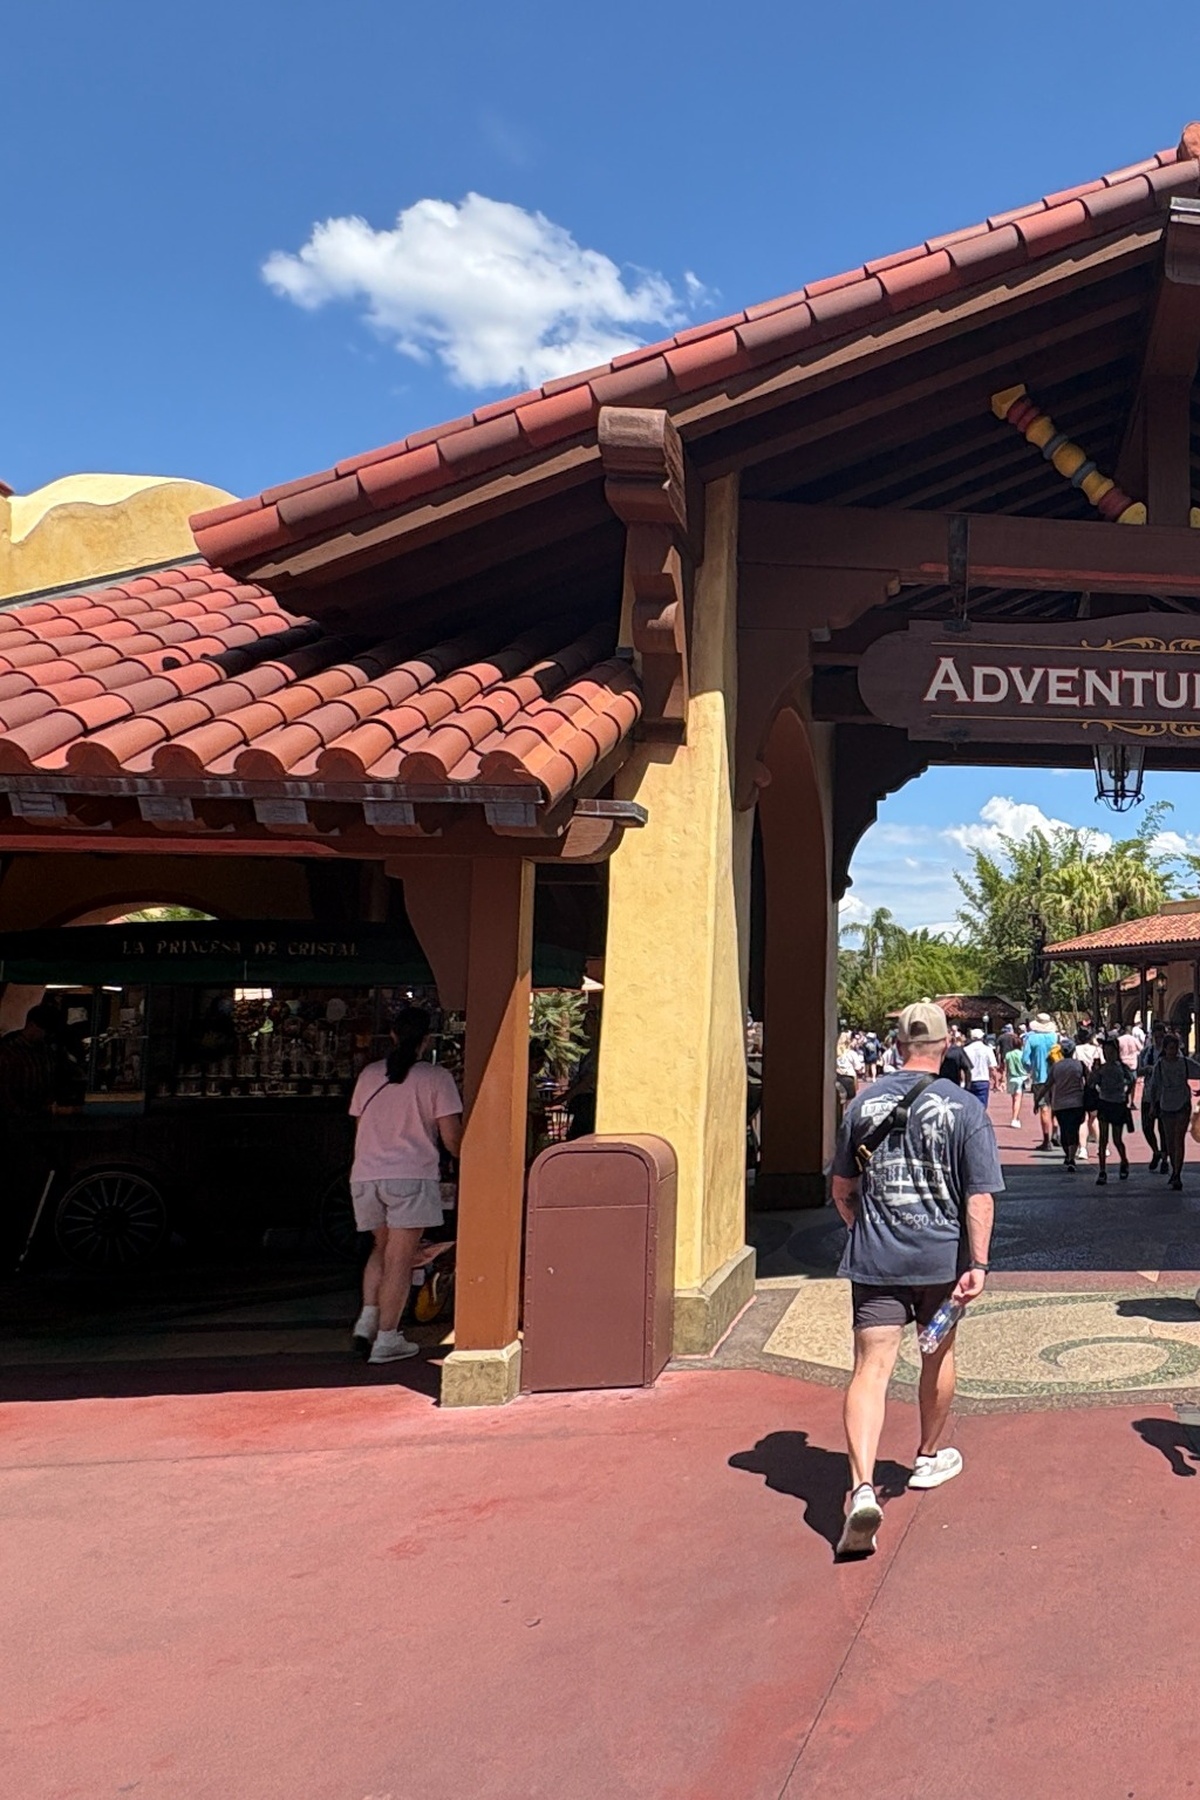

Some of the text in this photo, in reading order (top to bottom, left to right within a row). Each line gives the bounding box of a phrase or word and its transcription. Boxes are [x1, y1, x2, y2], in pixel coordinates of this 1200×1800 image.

[122, 940, 358, 955] LA PRINCESA DE CRISTAL
